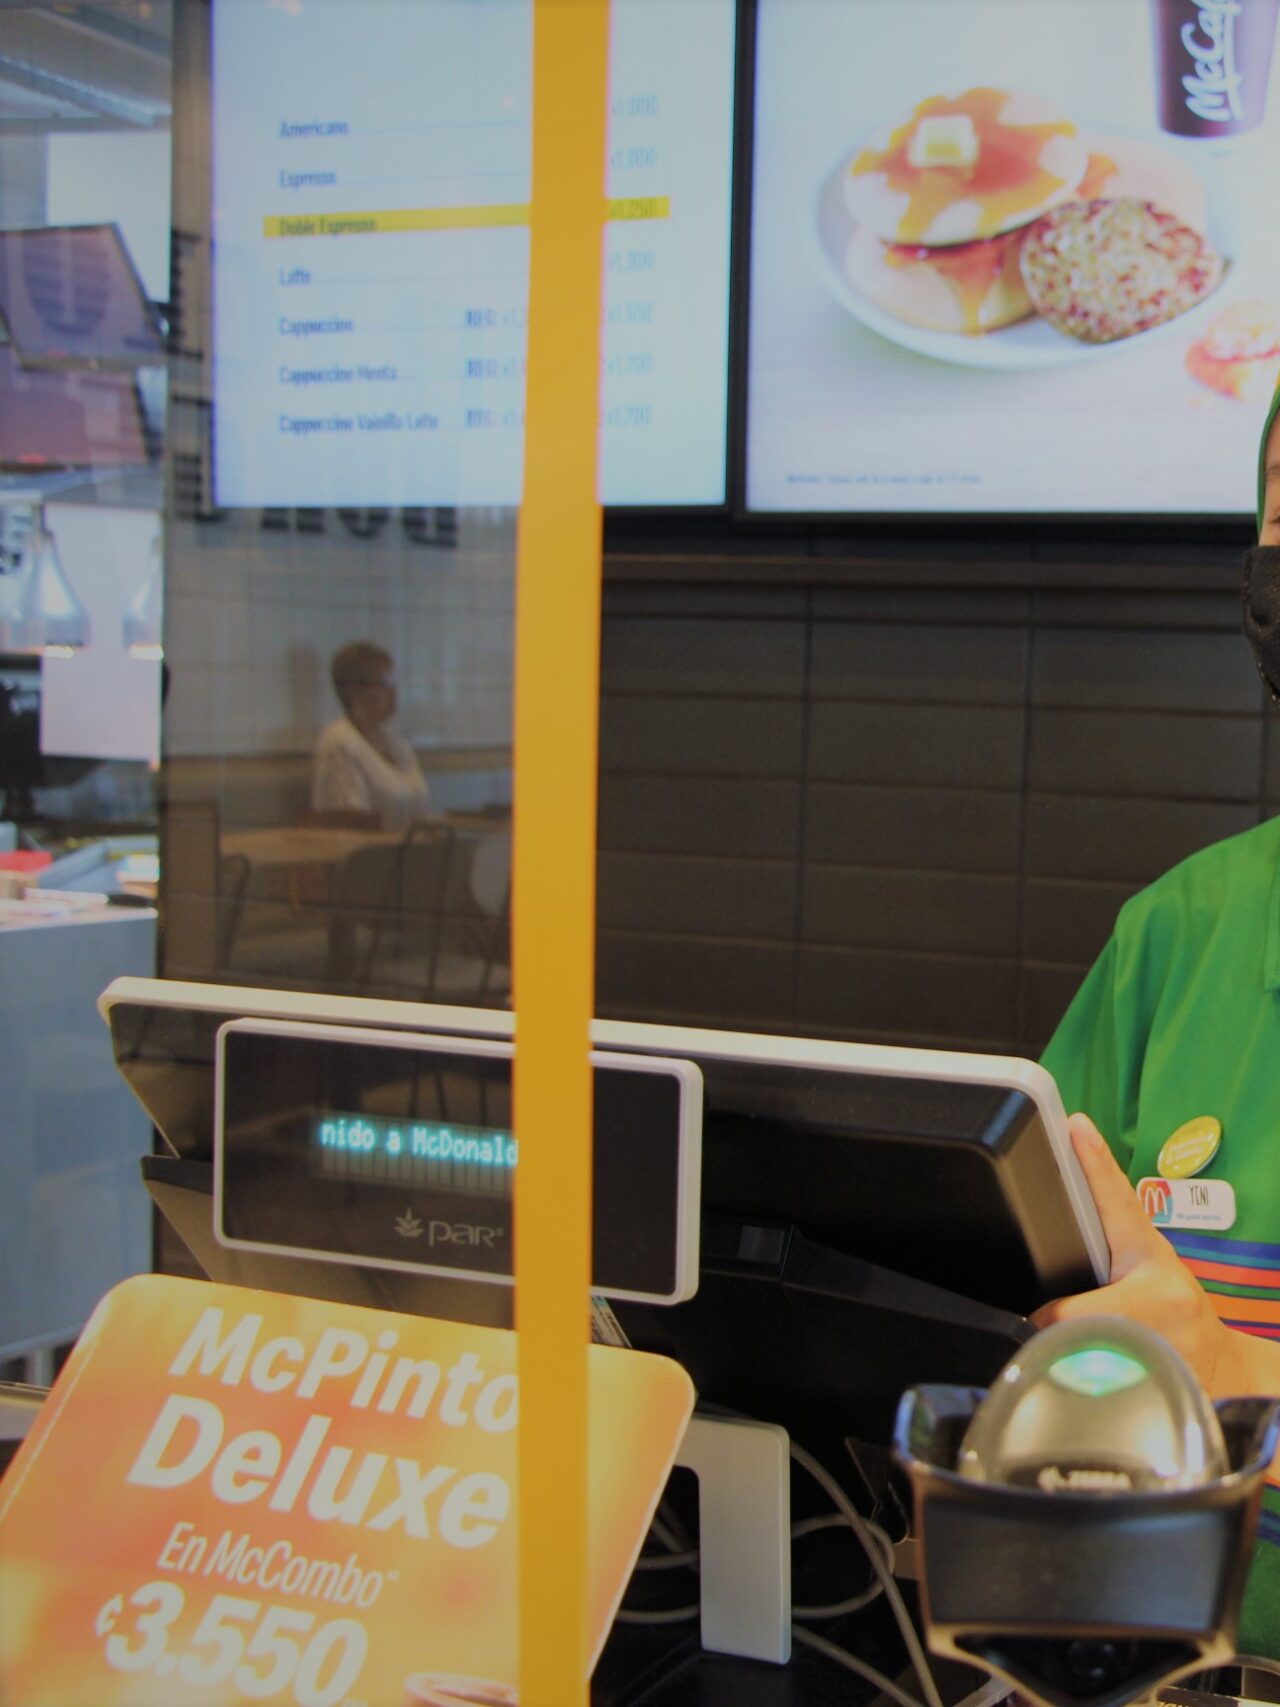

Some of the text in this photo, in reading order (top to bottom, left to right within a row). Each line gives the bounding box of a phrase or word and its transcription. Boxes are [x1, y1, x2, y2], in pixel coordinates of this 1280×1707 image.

[1181, 0, 1243, 122] McCaf
[279, 119, 350, 138] Americano
[279, 170, 338, 191] Espresso
[279, 215, 378, 237] Doble Espresso
[279, 267, 312, 286] Latte
[279, 316, 354, 339] Cappuccino
[279, 364, 353, 387] Cappuccino
[279, 413, 353, 436] Cappuccino
[406, 412, 439, 431] Latte
[320, 1118, 376, 1150] nido
[386, 1127, 402, 1155] a
[1188, 1185, 1209, 1206] YENI
[168, 1307, 520, 1433] McPinto
[126, 1394, 510, 1549] Deluxe
[157, 1521, 207, 1574] En
